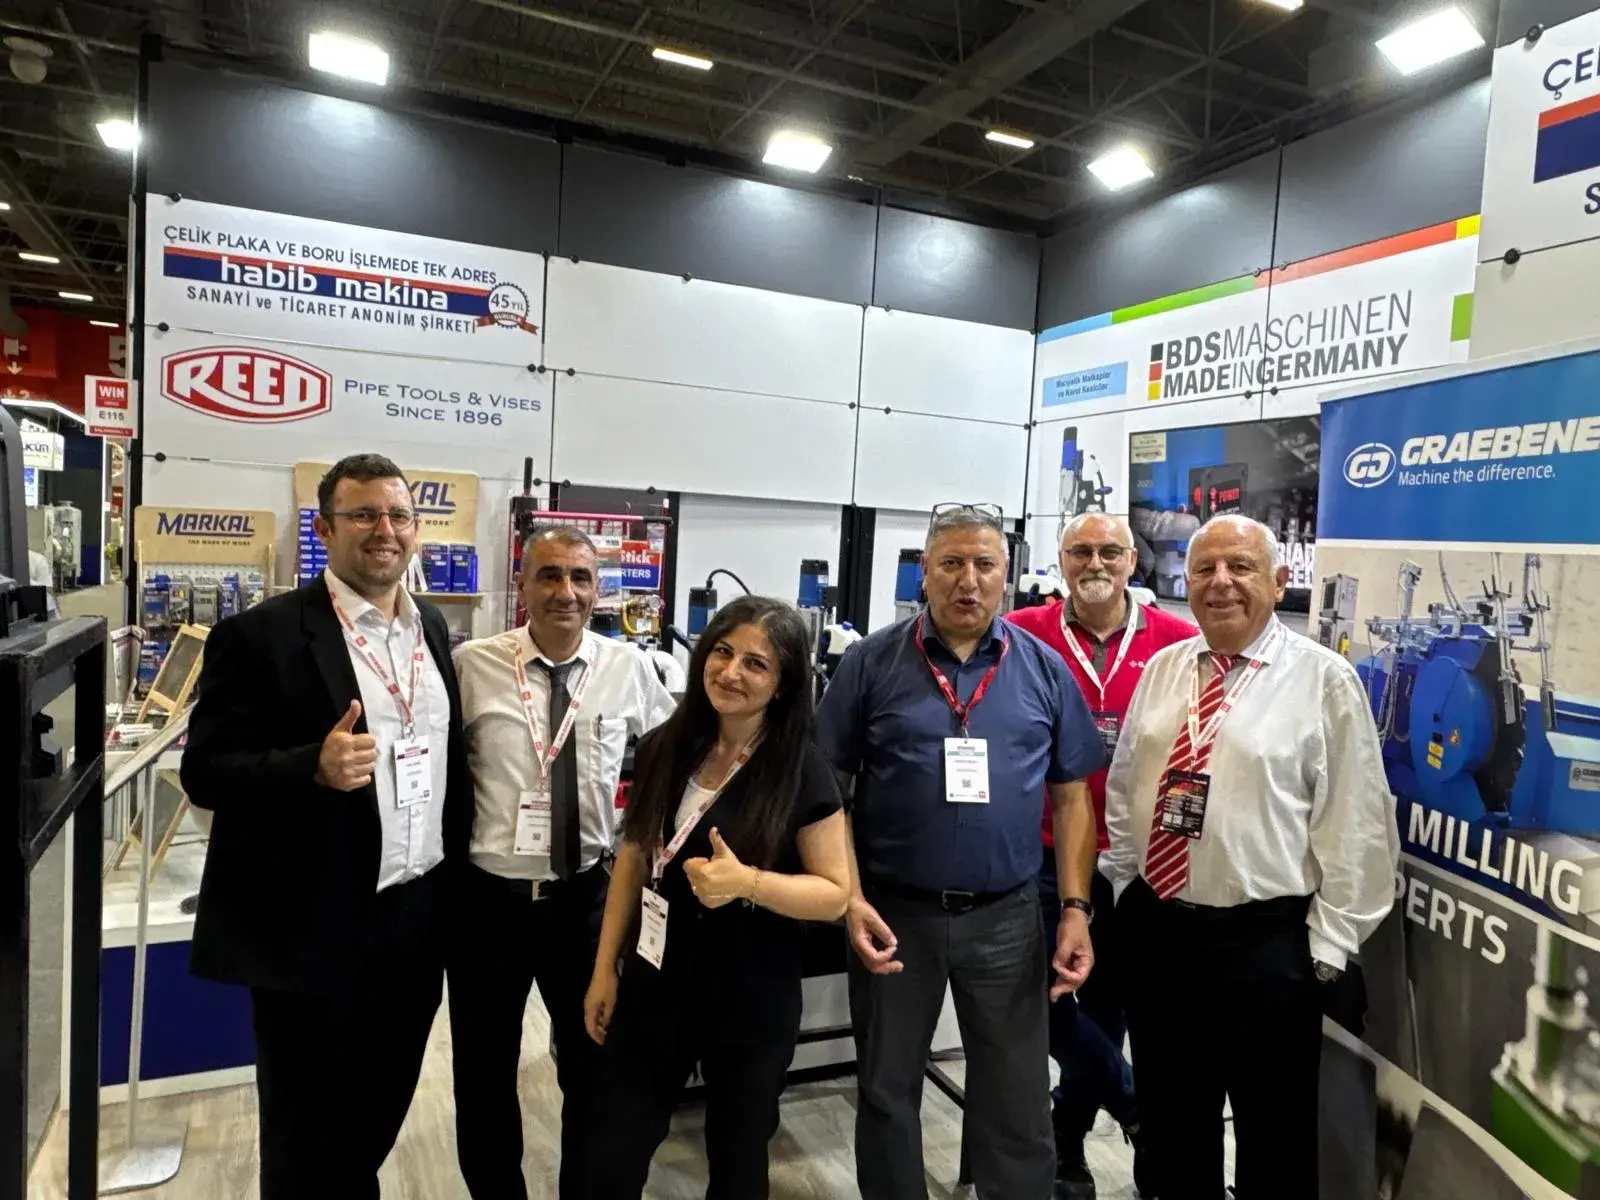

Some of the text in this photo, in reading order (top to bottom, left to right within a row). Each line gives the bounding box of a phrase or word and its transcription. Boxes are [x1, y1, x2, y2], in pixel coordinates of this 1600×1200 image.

[1543, 46, 1600, 100] ÇE
[164, 225, 496, 284] ÇELİK PLAKA VE BORU İŞLEMEDE TEK ADRES
[221, 256, 448, 310] habib makina
[491, 293, 510, 309] 45
[187, 285, 250, 307] SANAYİ
[256, 297, 272, 310] ve
[280, 295, 347, 318] TİCARET
[351, 307, 415, 327] ANONİM
[420, 314, 476, 334] ŞİRKETİ
[98, 385, 125, 399] WIN
[172, 353, 324, 414] REED
[344, 379, 542, 411] PIPE TOOLS & VISES
[386, 402, 503, 426] SINCE 1896
[1400, 416, 1600, 466] GRAEBENE
[1398, 462, 1556, 487] Machine the difference.
[157, 512, 255, 536] MARKAL
[620, 568, 652, 579] RTERS
[1407, 802, 1584, 915] MILLING
